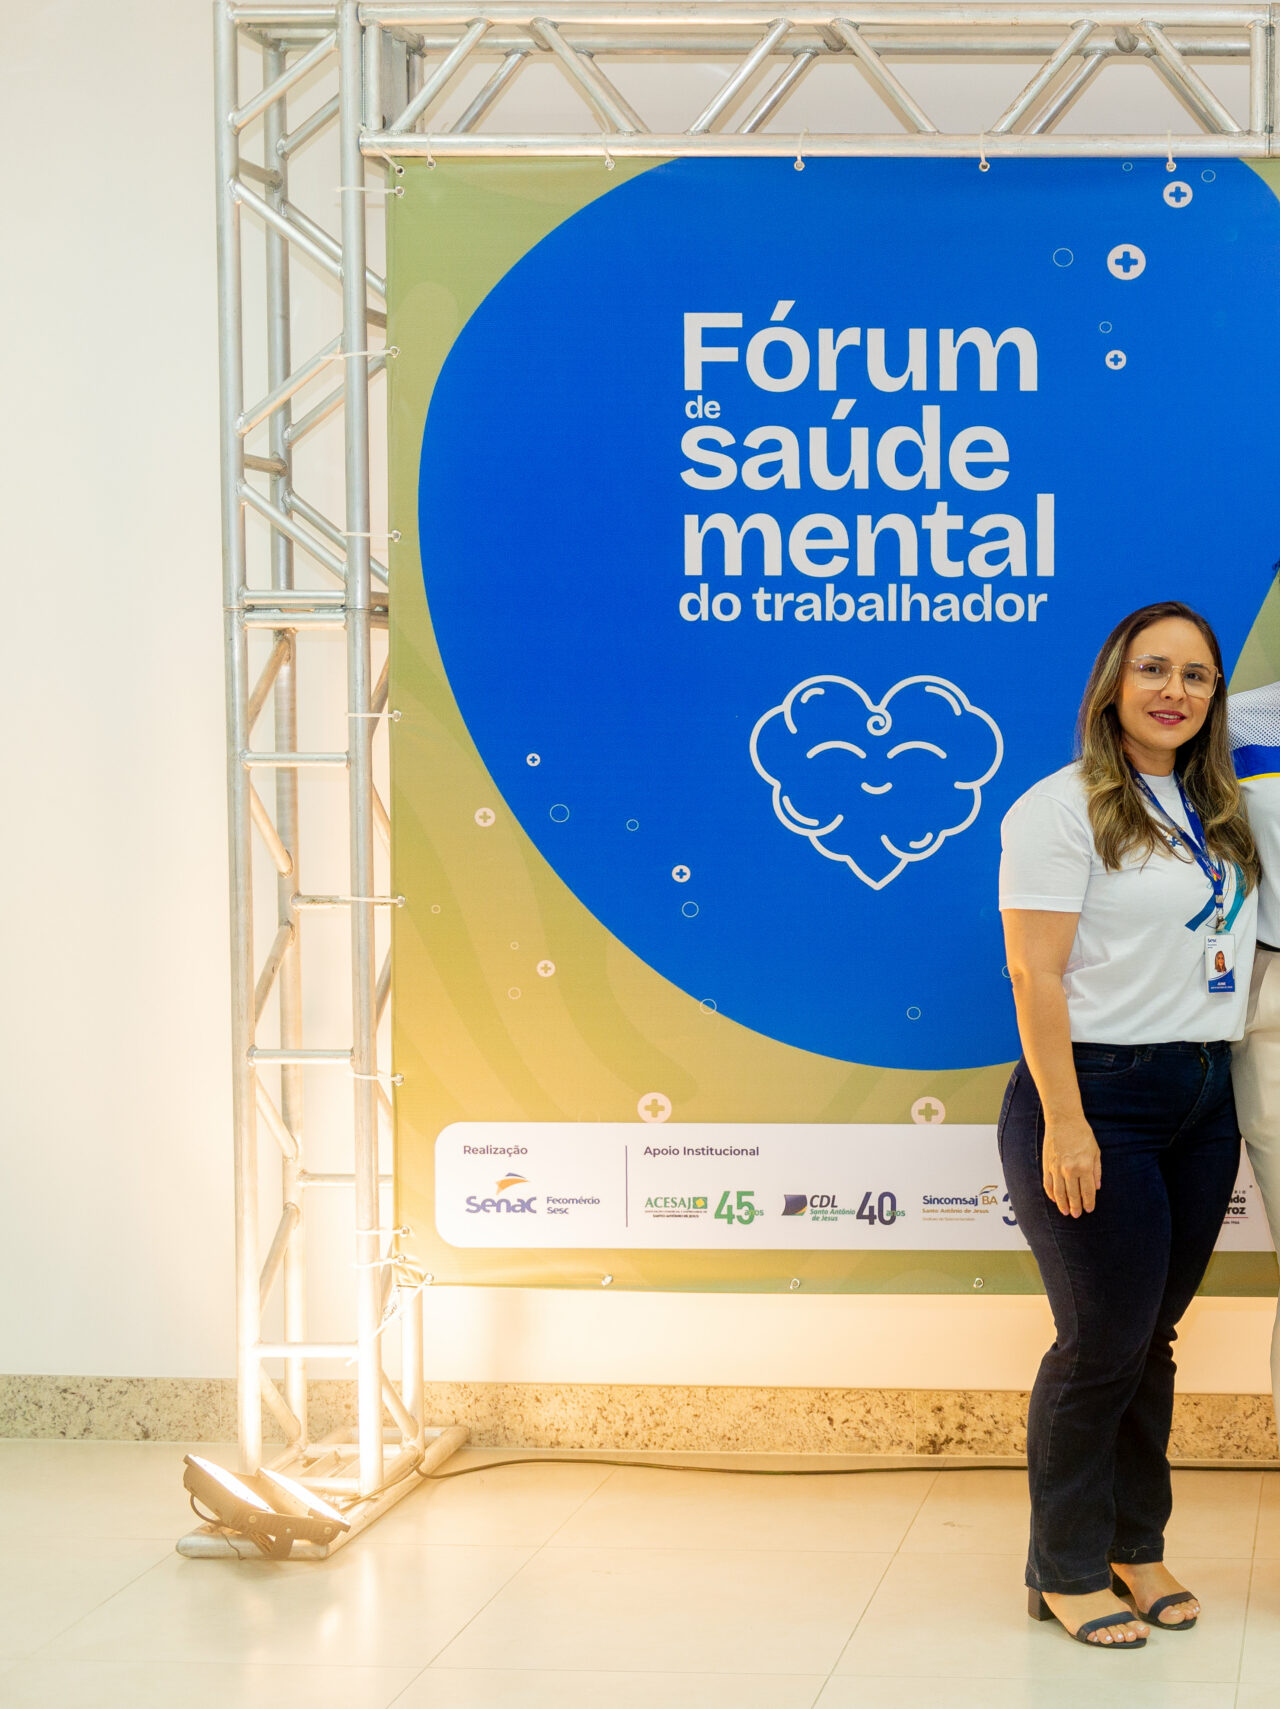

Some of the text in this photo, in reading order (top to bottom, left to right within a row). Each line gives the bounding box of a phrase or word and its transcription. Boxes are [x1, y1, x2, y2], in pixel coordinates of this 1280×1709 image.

[684, 300, 1038, 393] Fórum
[685, 395, 721, 419] de
[680, 399, 1010, 491] saúde
[684, 493, 1055, 578] mental
[679, 583, 1048, 622] do trabalhador
[463, 1145, 528, 1157] Realização
[644, 1146, 759, 1158] Apoio Institucional
[465, 1195, 537, 1214] Senac
[546, 1196, 601, 1205] Fecomércio
[645, 1196, 691, 1210] ACESAJ
[714, 1191, 755, 1225] 45
[809, 1195, 838, 1208] CDL
[922, 1195, 979, 1207] Sincomsaj
[982, 1195, 998, 1205] BA
[547, 1206, 569, 1215] Sesc
[856, 1191, 897, 1226] 40
